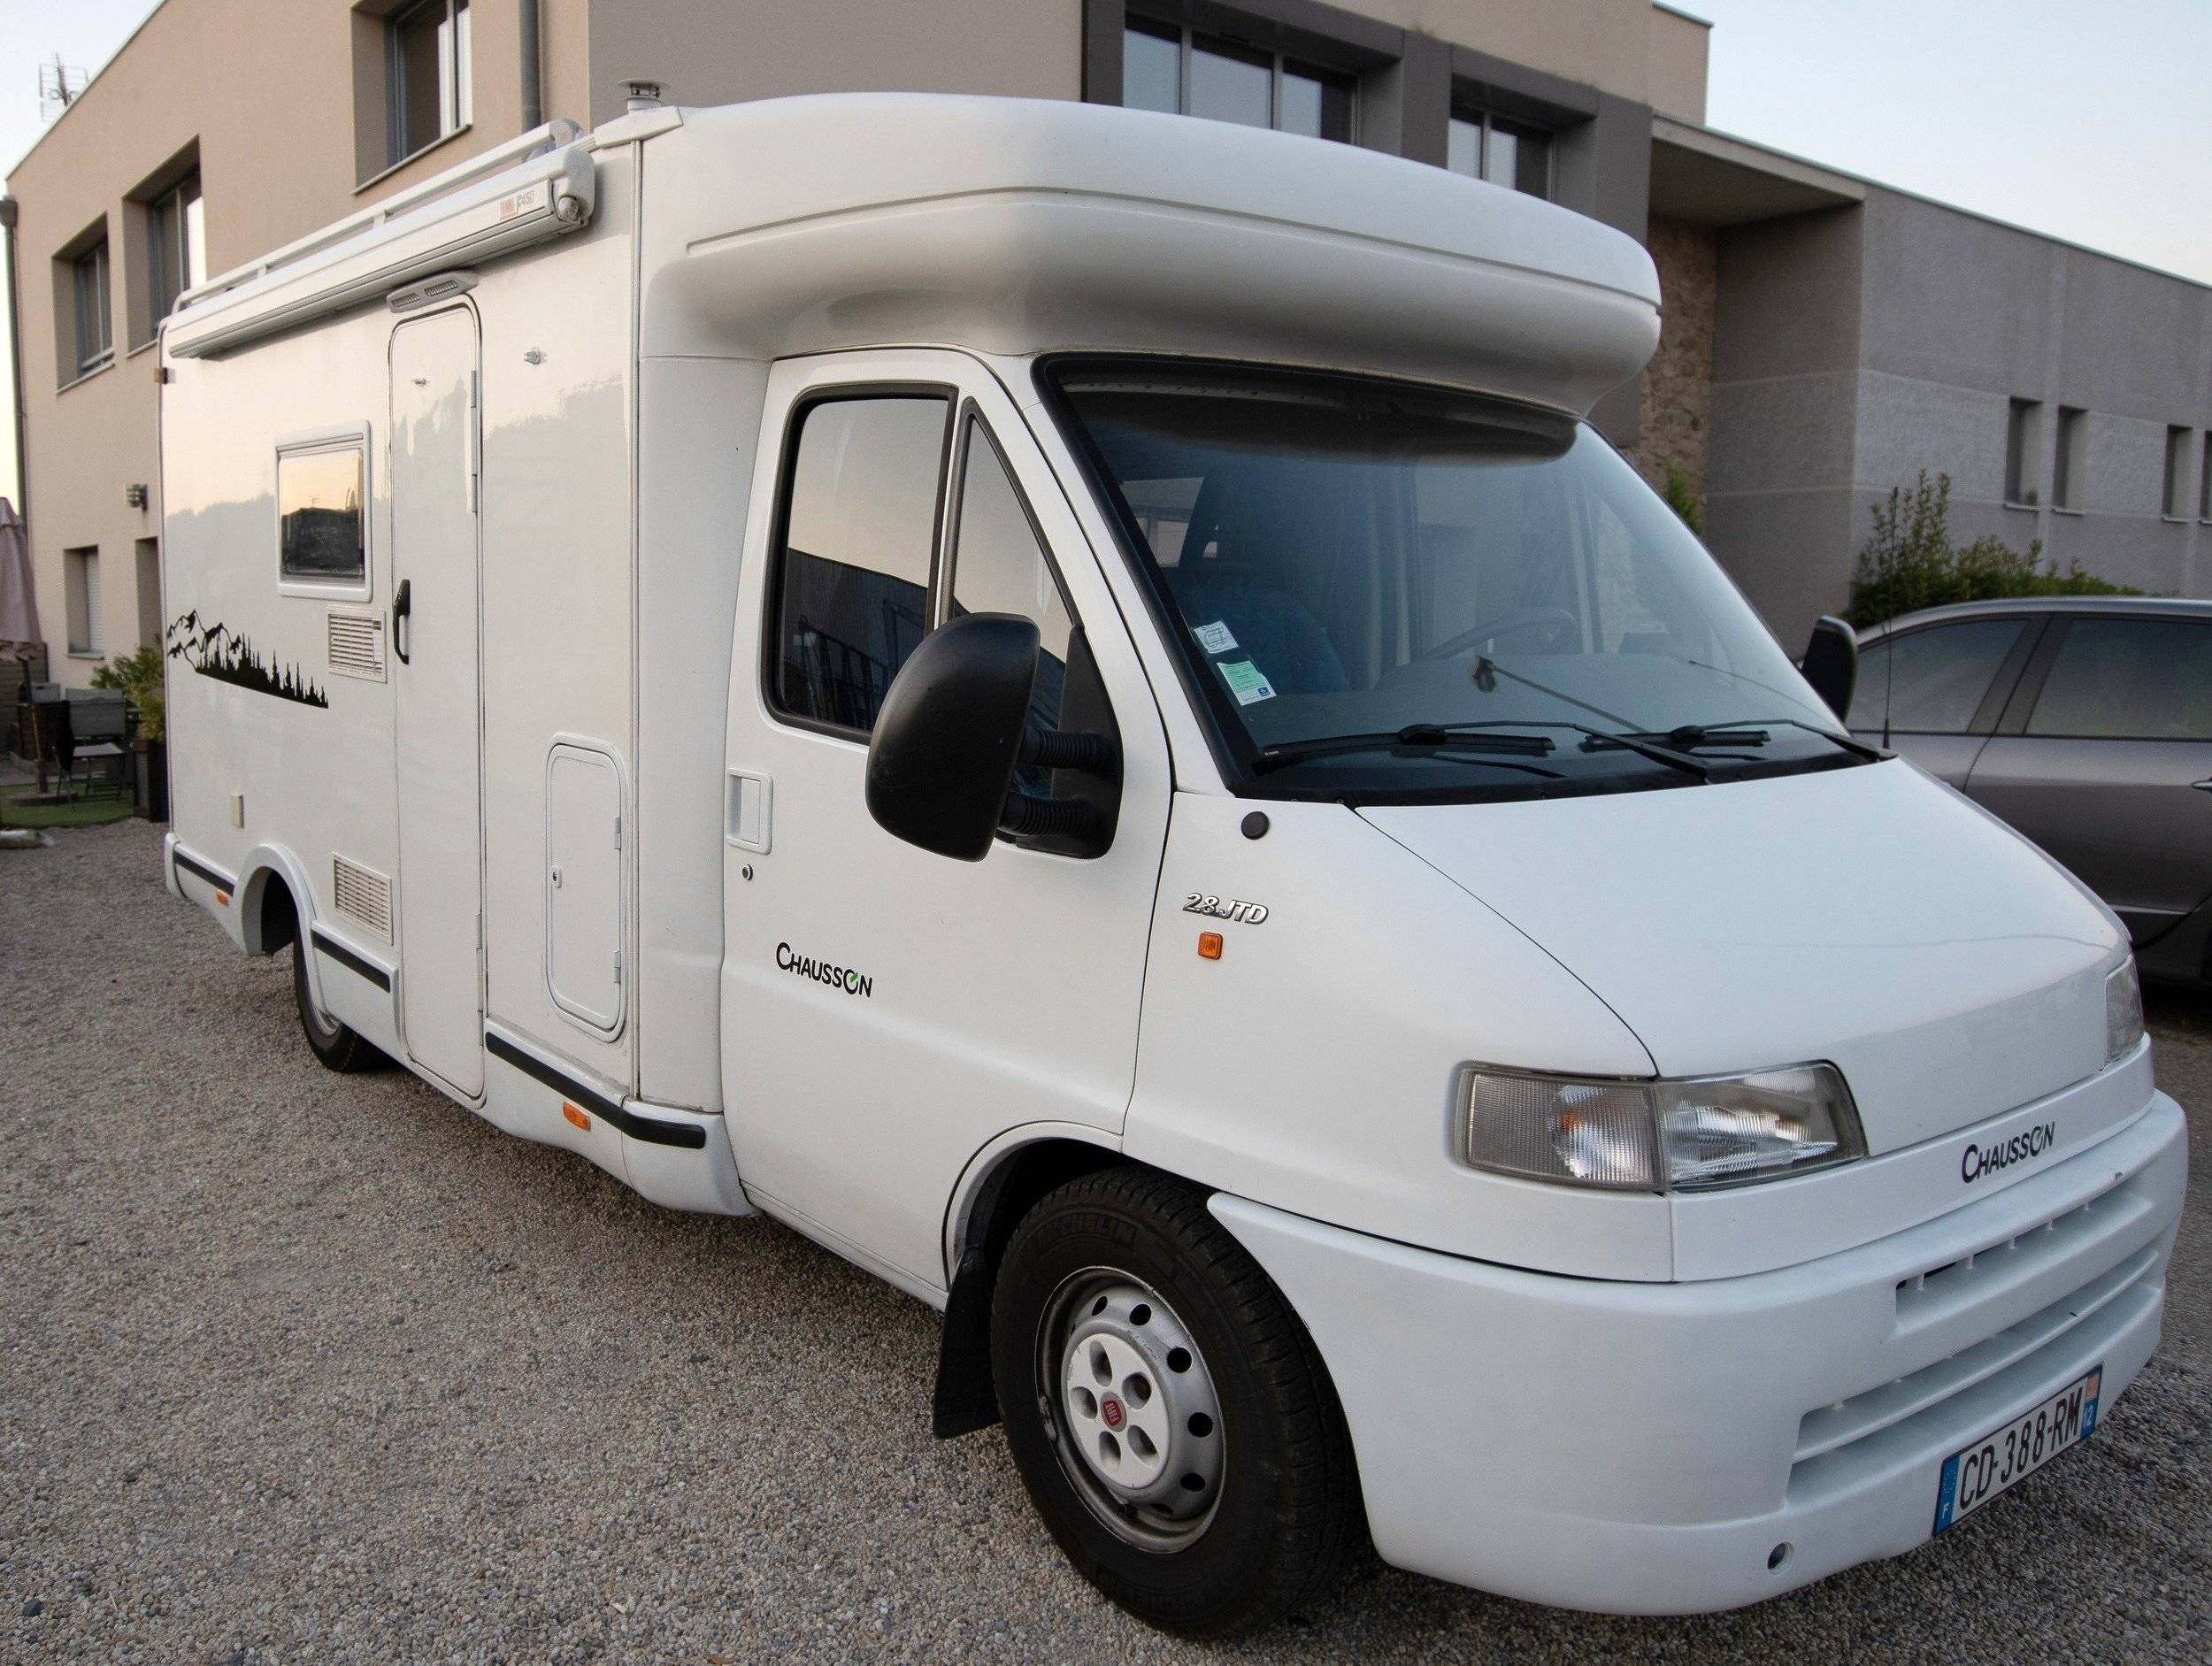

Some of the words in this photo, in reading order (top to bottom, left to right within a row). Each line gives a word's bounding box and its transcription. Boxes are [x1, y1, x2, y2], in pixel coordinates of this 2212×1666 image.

[1218, 899, 1270, 925] JTD
[776, 941, 872, 998] CHAUSSON
[1962, 1120, 2055, 1183] CHAUSSON
[1105, 1402, 1120, 1423] FIAT
[1959, 1386, 2083, 1510] CD-388-RM
